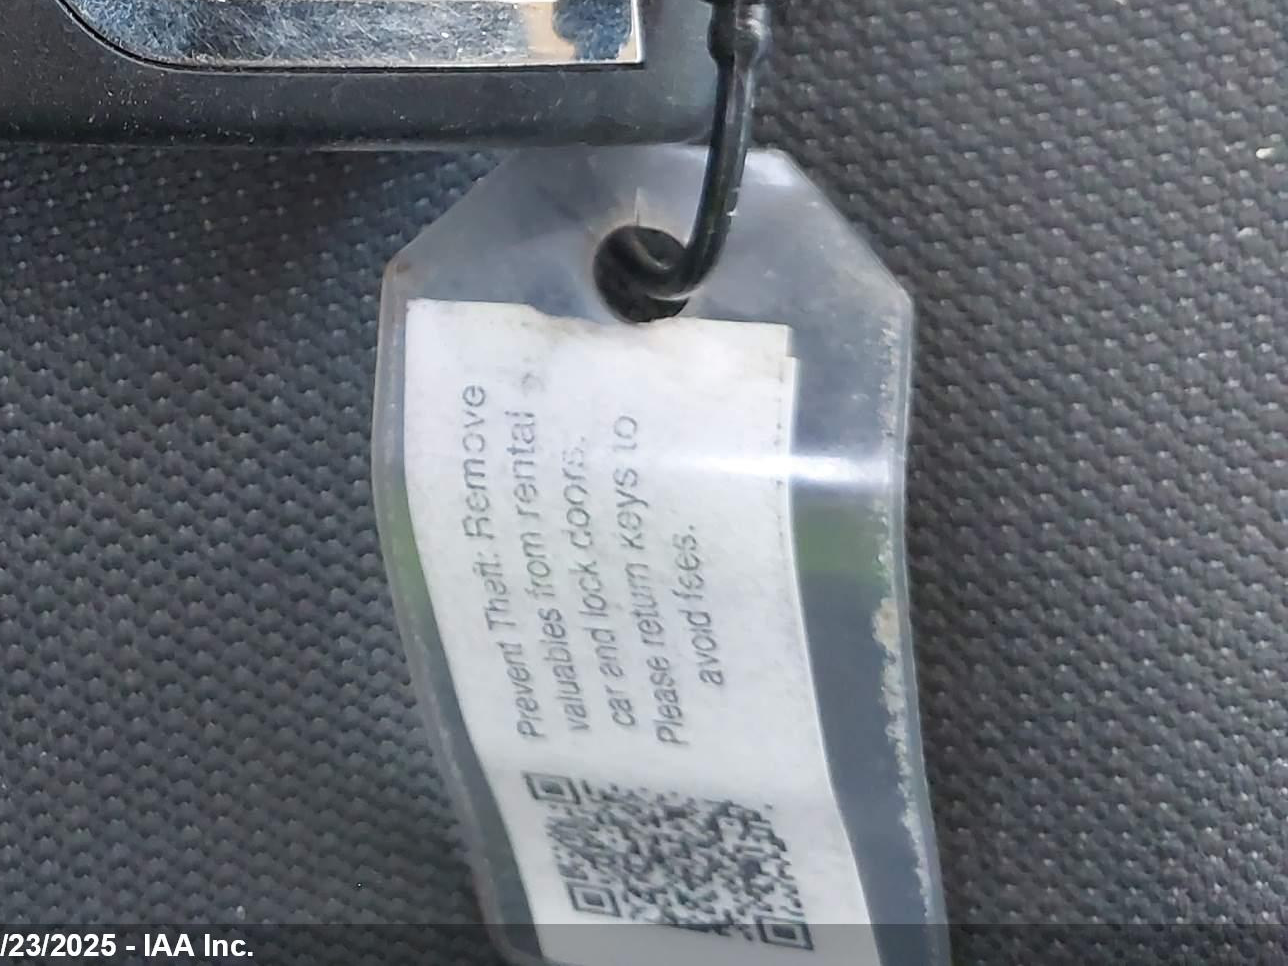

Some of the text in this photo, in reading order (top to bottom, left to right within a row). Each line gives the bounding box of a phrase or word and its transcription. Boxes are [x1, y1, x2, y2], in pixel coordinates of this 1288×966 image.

[462, 384, 545, 739] Prevent Theft: Remove
[505, 409, 591, 733] valuables from rental
[569, 558, 608, 624] lock
[612, 415, 690, 747] Please return keys to
[671, 524, 726, 687] avoid fees.
[583, 628, 625, 682] and
[606, 683, 638, 730] car
